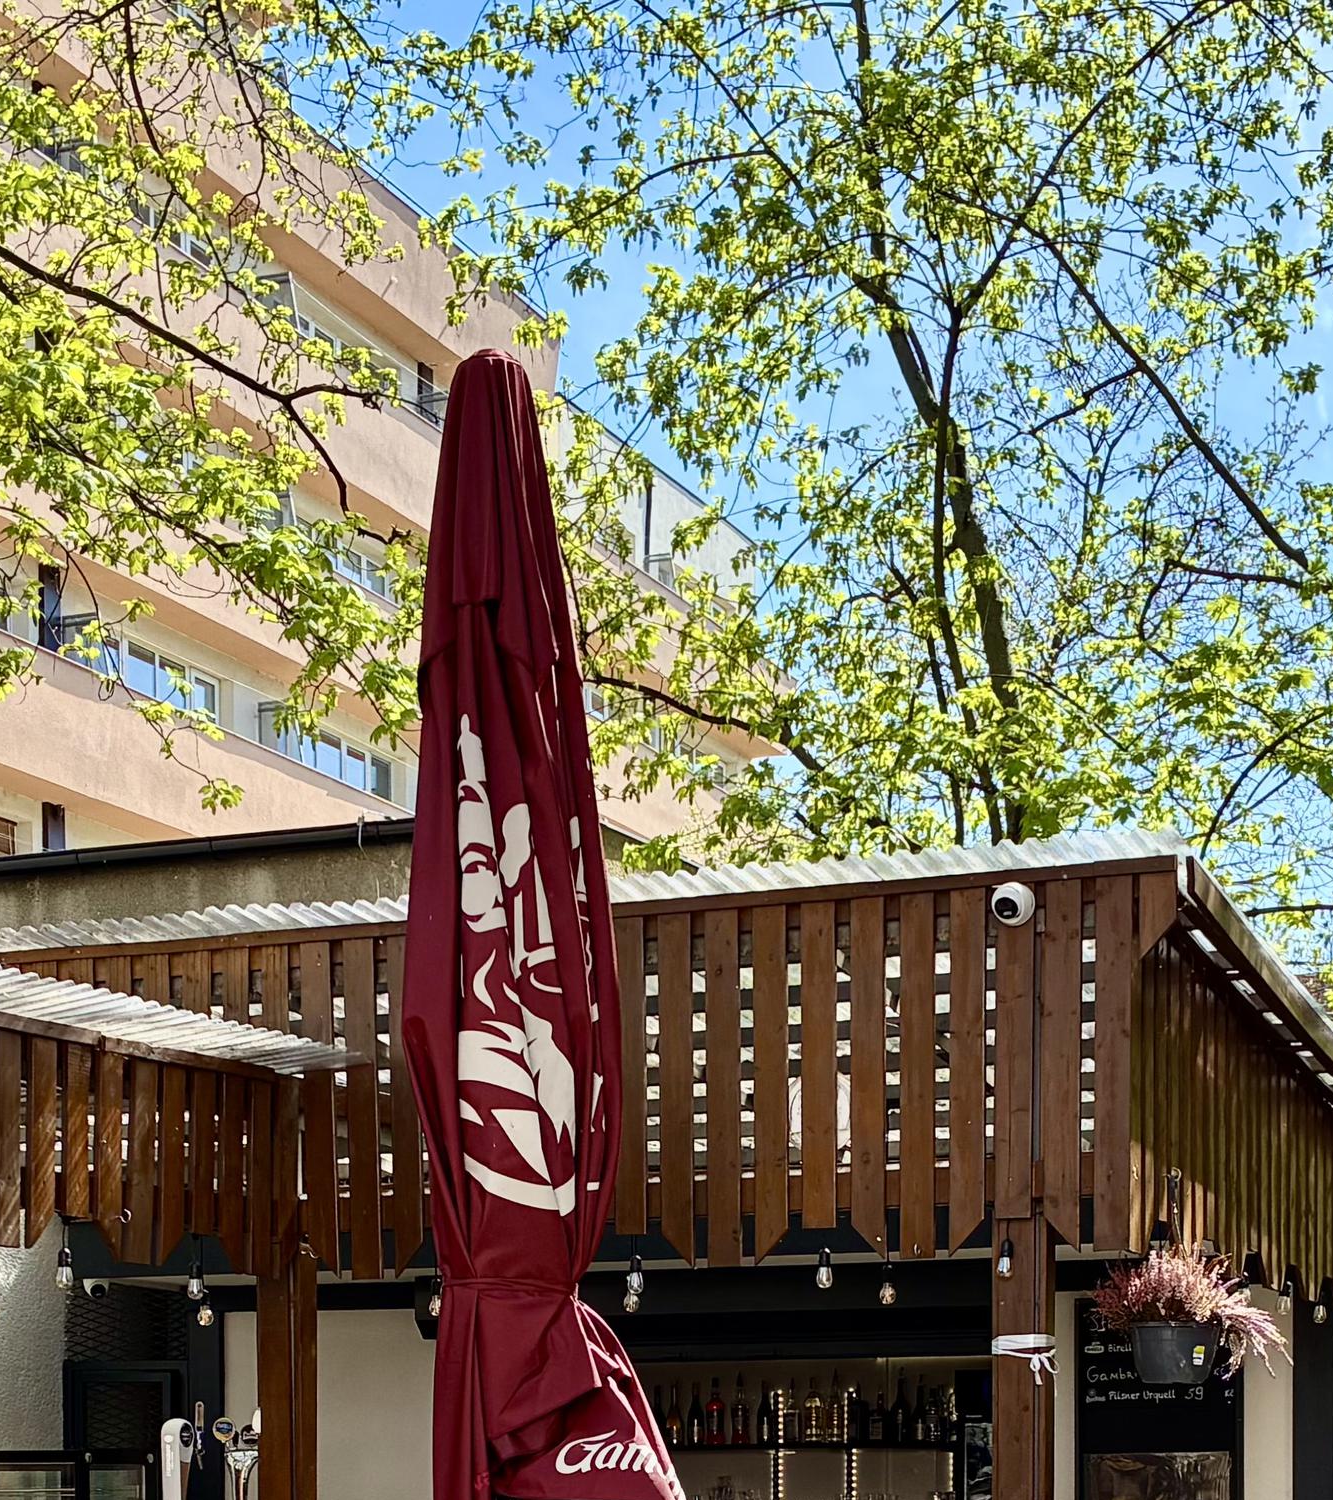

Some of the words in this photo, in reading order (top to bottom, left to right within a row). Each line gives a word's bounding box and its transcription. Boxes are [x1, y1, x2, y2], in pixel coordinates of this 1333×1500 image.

[1108, 1390, 1140, 1401] Pilsner
[1142, 1389, 1176, 1404] Urquell
[1184, 1386, 1204, 1401] 59
